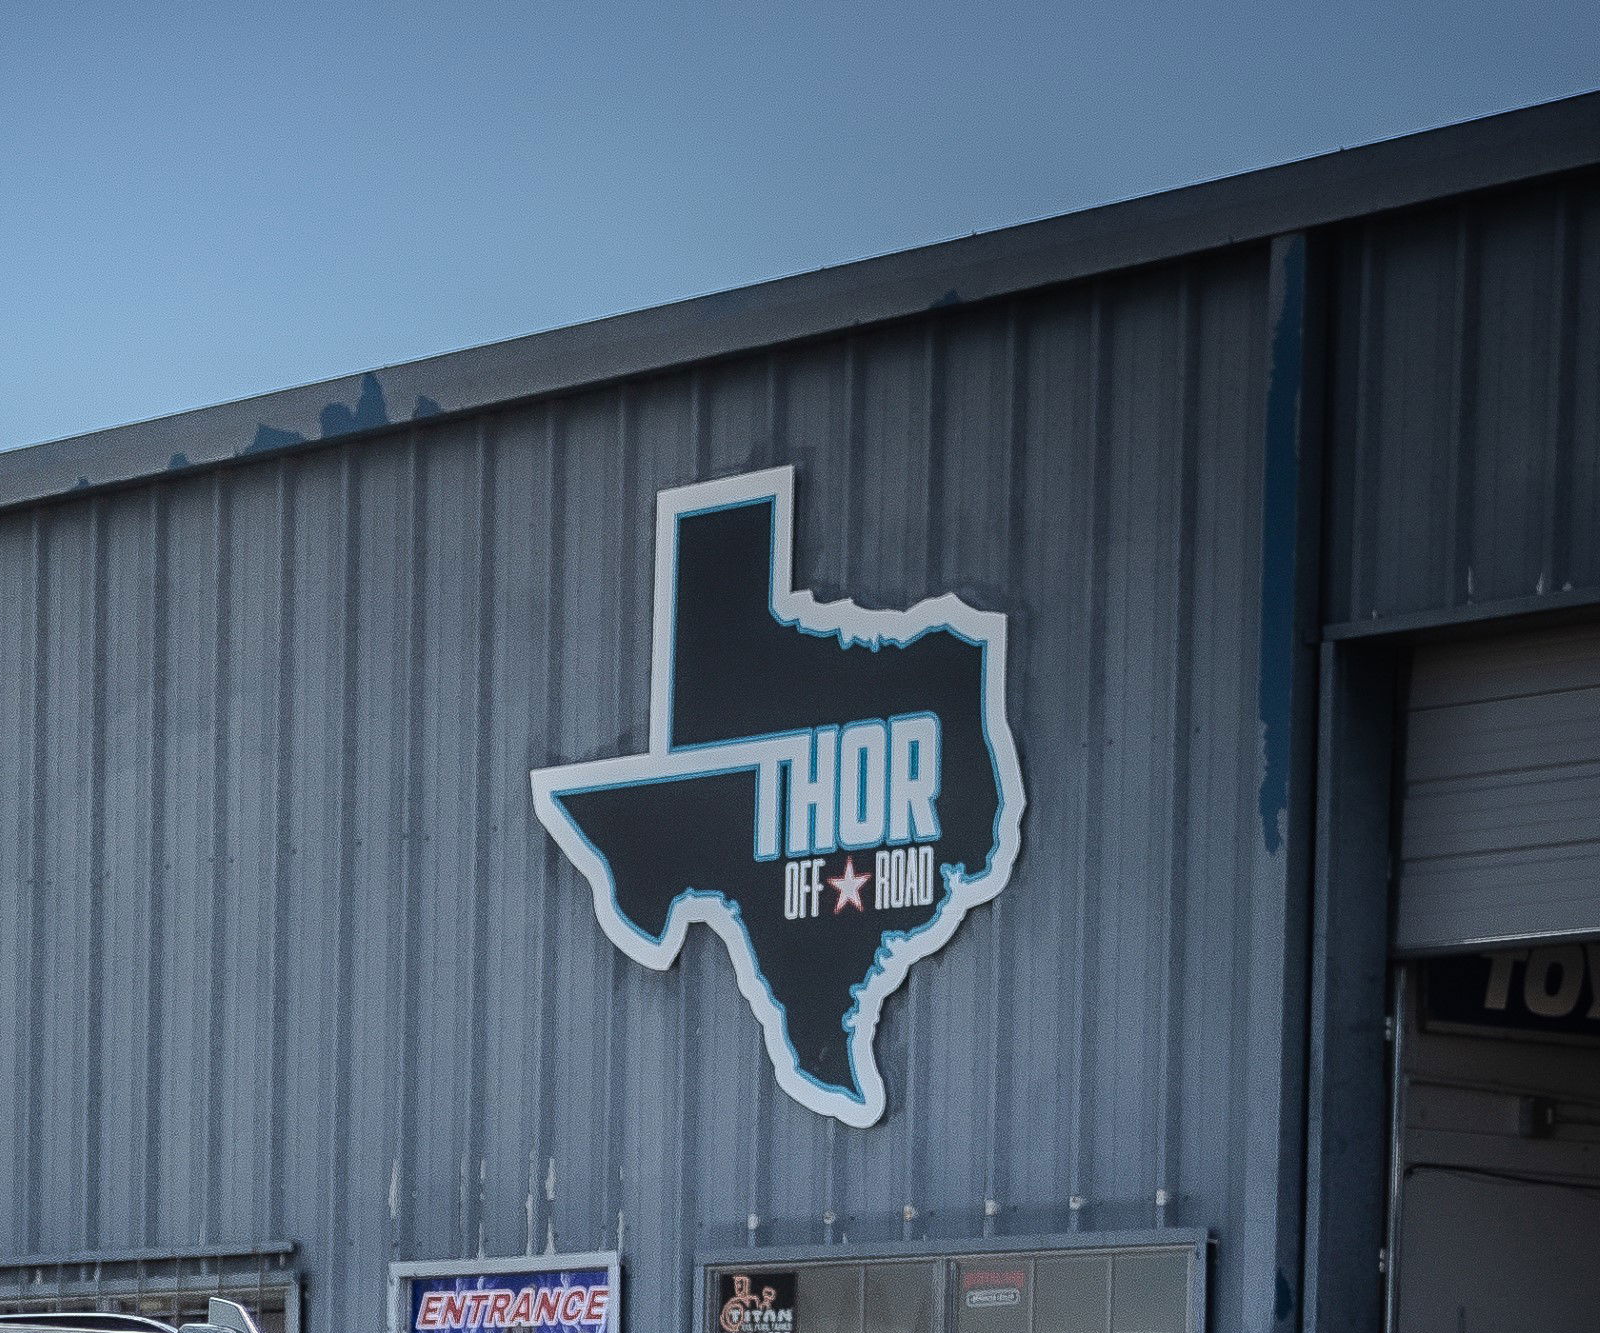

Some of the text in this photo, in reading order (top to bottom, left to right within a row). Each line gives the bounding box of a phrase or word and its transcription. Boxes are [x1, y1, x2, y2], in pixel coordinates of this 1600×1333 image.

[752, 710, 943, 863] THOR
[784, 845, 935, 920] OFF ROAD
[1480, 943, 1600, 1019] TO
[415, 1285, 609, 1330] ENTRANCE
[728, 1308, 793, 1323] TITAN
